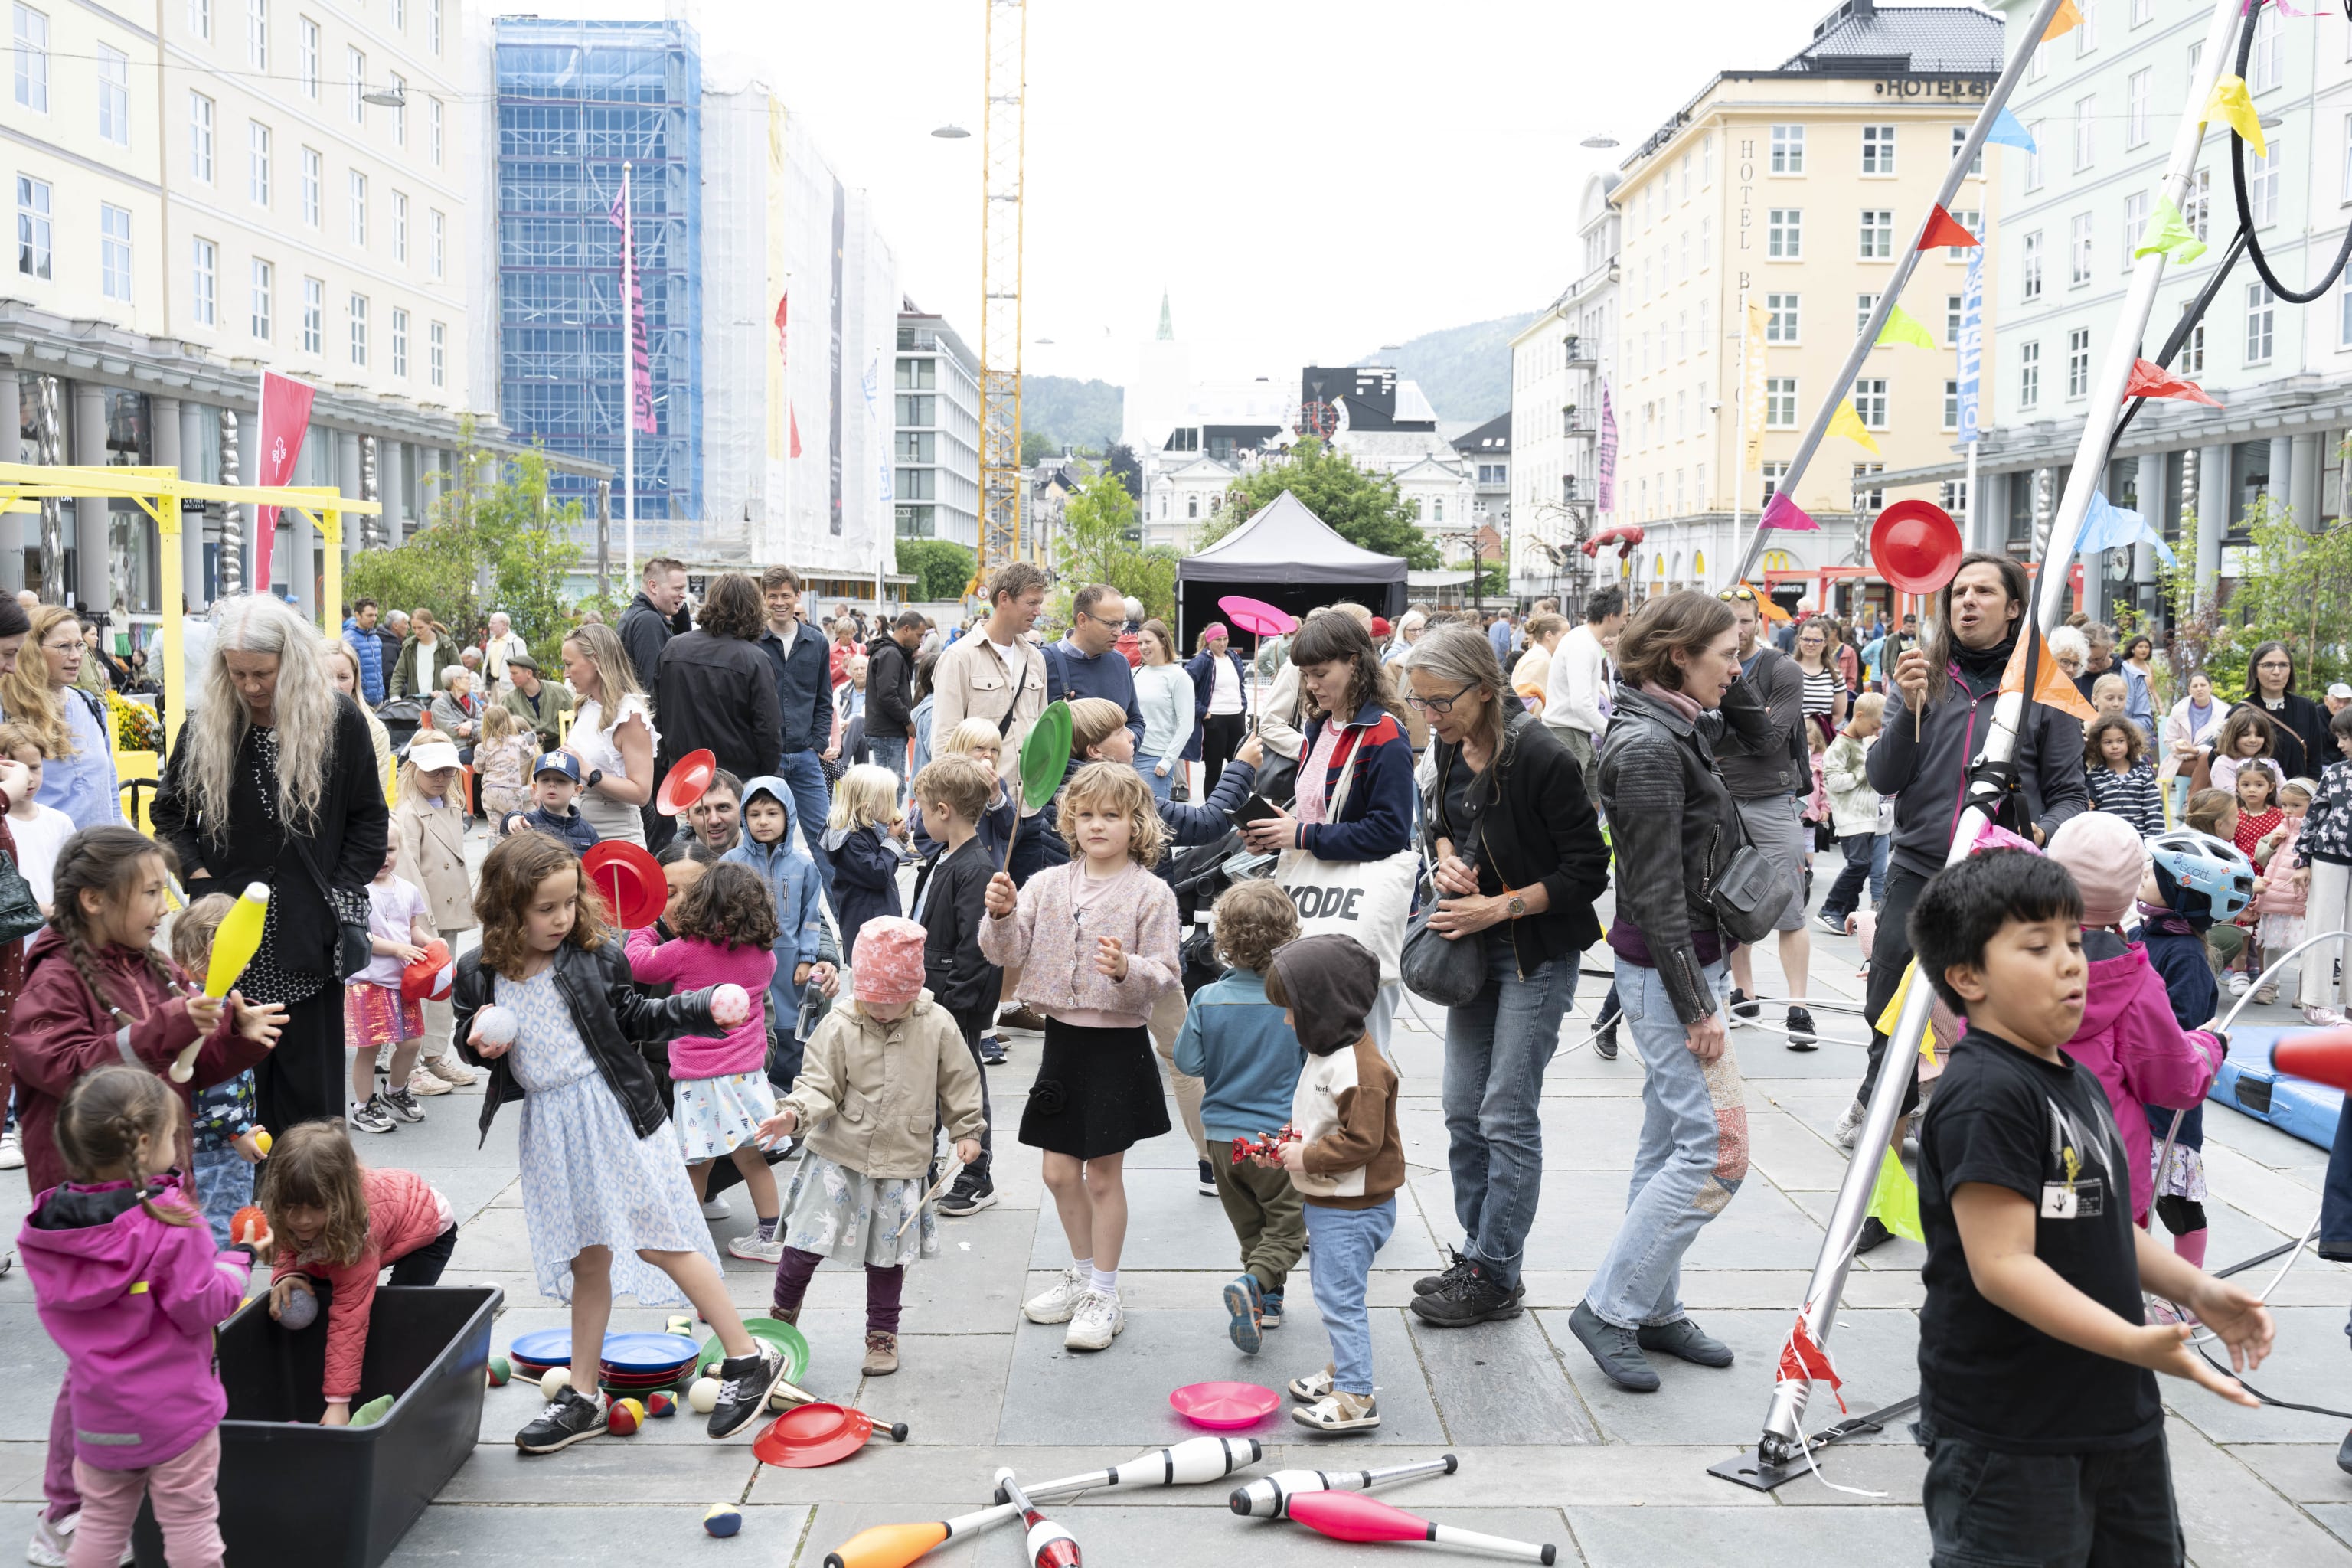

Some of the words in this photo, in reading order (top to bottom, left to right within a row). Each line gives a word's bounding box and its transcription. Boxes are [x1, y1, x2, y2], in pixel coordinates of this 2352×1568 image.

[1886, 80, 1965, 96] HOTEL
[1740, 140, 1754, 250] HOTEL
[2179, 863, 2211, 882] scott
[1282, 885, 1365, 920] KODE
